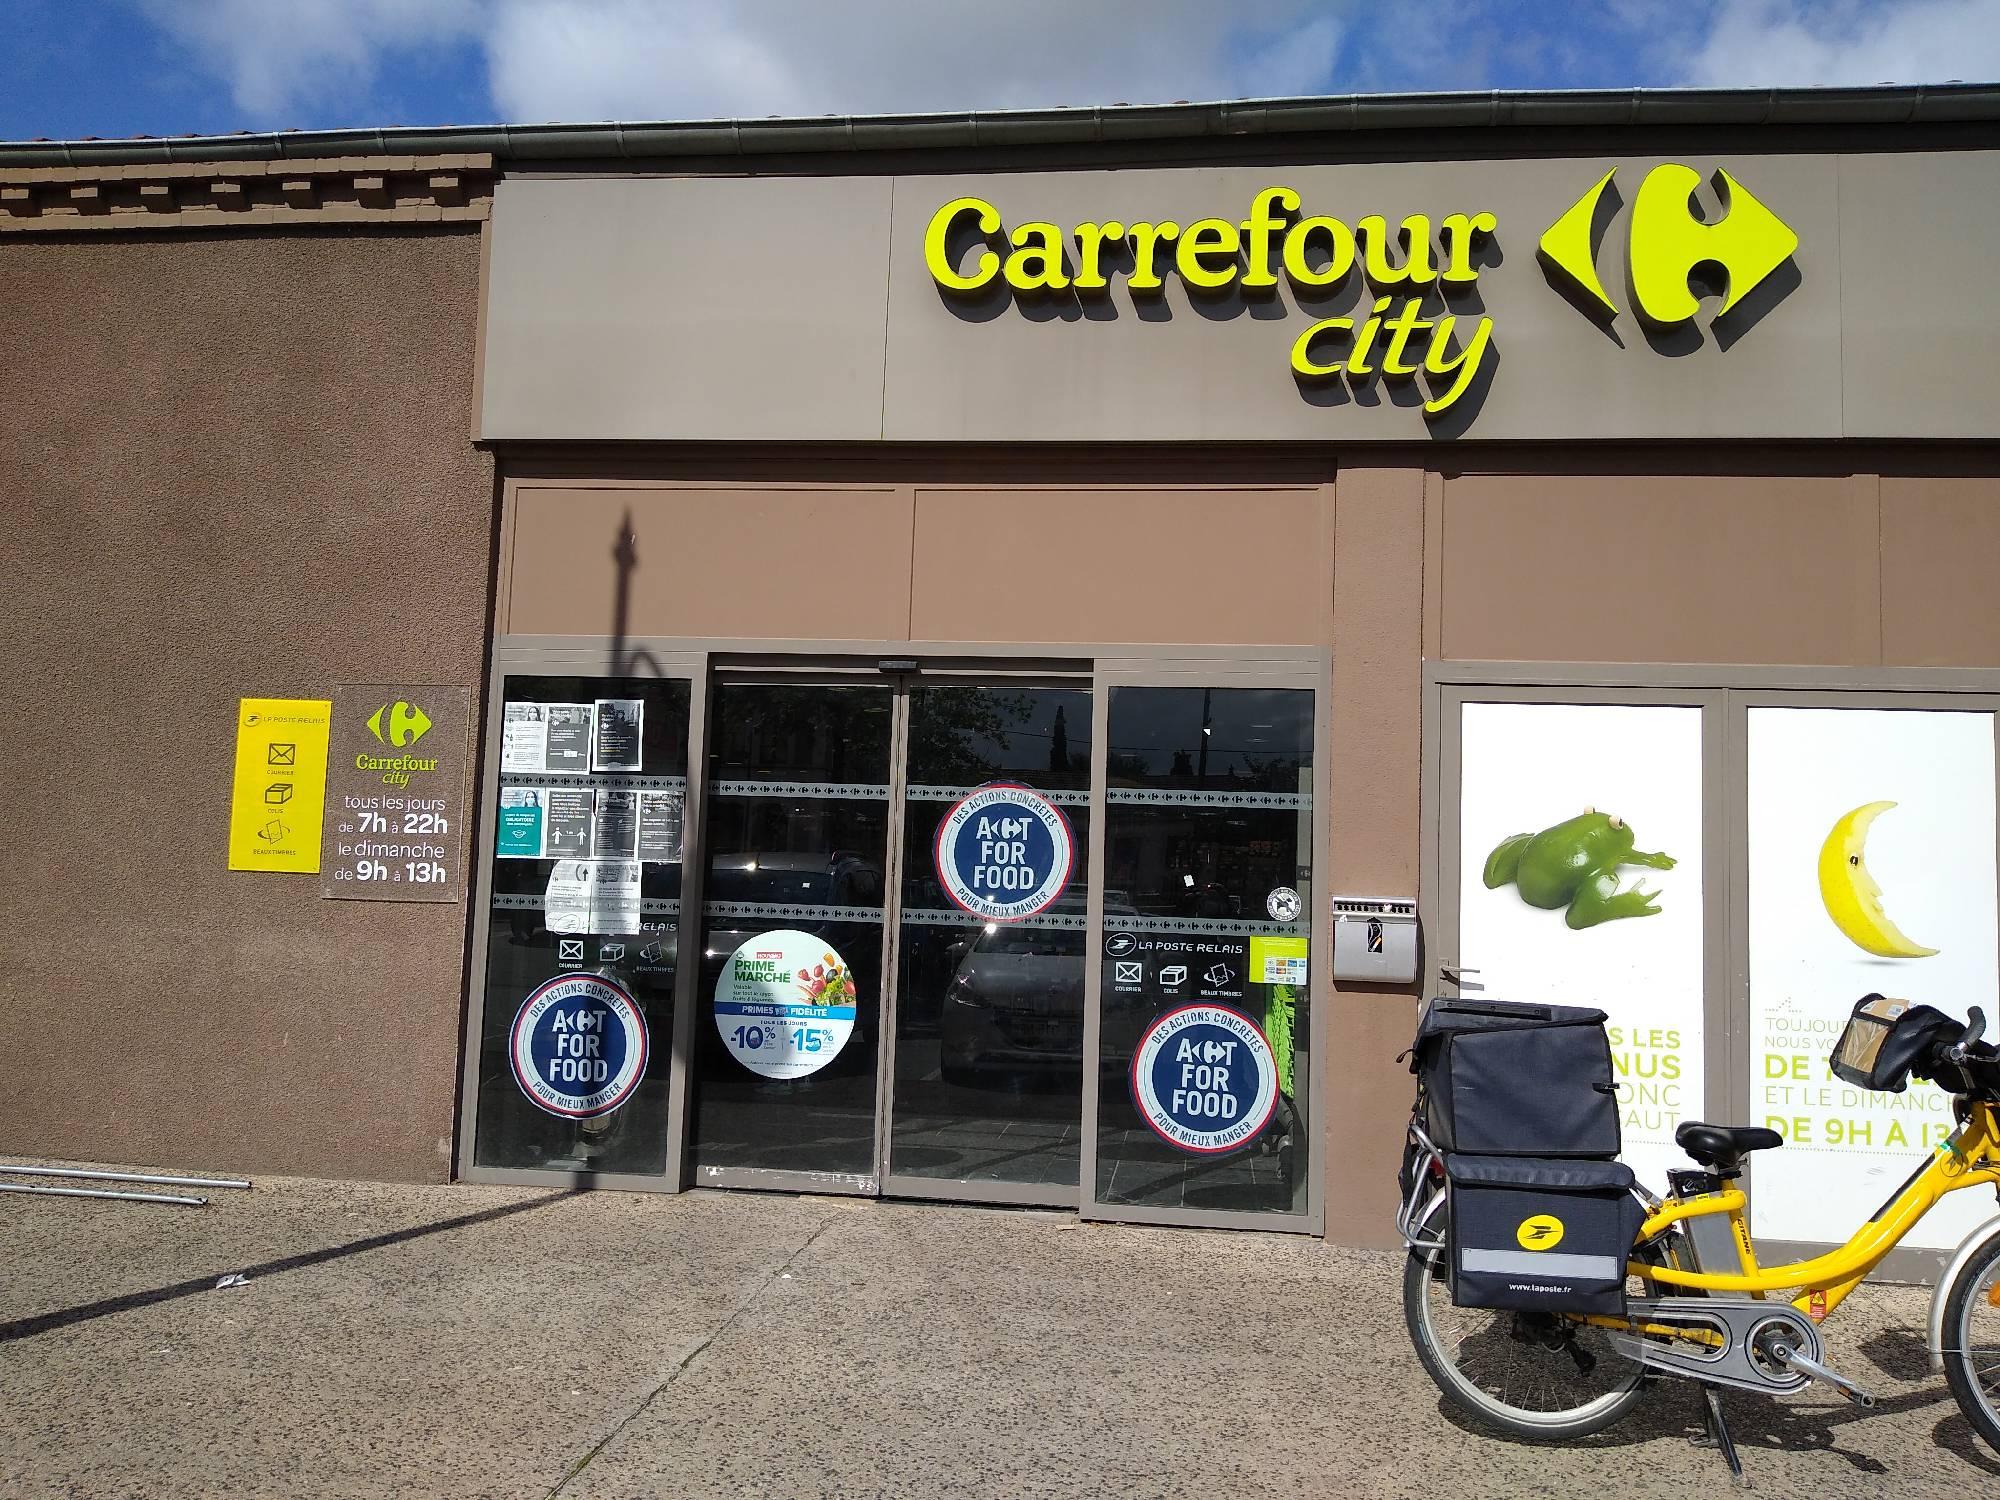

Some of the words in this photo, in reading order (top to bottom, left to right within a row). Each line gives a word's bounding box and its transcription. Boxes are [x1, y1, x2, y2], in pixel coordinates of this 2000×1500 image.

[924, 186, 1497, 290] Carrefour
[1291, 295, 1494, 414] city
[356, 753, 438, 771] Carrefour
[382, 771, 411, 789] city
[345, 795, 379, 809] tous
[382, 794, 404, 810] les
[405, 795, 446, 813] jours
[952, 807, 970, 825] DES
[969, 791, 1007, 809] ACTIONS
[338, 822, 354, 833] de
[358, 811, 387, 833] 7h
[391, 821, 399, 834] à
[403, 812, 448, 834] 22h
[338, 841, 352, 856] le
[354, 840, 445, 859] dimanche
[980, 841, 1026, 865] FOR
[334, 867, 353, 880] de
[356, 860, 388, 881] 9h
[393, 870, 401, 882] à
[405, 861, 446, 883] 13h
[973, 866, 1035, 890] FOOD
[956, 887, 980, 909] POUR
[980, 903, 1010, 917] MIEUX
[1012, 891, 1050, 916] MANGER
[636, 921, 677, 932] RELAIS
[1138, 941, 1152, 950] LA
[1156, 942, 1193, 952] POSTE
[1196, 943, 1243, 954] RELAIS
[734, 970, 791, 983] MARCHÉ
[735, 960, 775, 972] PRIME
[530, 999, 546, 1018] DES
[546, 983, 583, 1004] ACTIONS
[742, 1005, 774, 1015] PRIMES
[1151, 1025, 1170, 1045] DES
[1169, 1011, 1210, 1031] ACTIONS
[1608, 1027, 1624, 1046] S
[1633, 1028, 1681, 1049] LES
[557, 1033, 600, 1057] FOR
[1765, 1036, 1811, 1049] NOUS
[1815, 1038, 1837, 1050] VO
[549, 1058, 608, 1082] FOOD
[1181, 1063, 1230, 1092] FOR
[1611, 1052, 1681, 1080] NUS
[1765, 1054, 1810, 1080] DE
[532, 1080, 556, 1103] POUR
[556, 1097, 585, 1110] MIEUX
[587, 1082, 623, 1109] MANGER
[1172, 1089, 1238, 1119] FOOD
[1617, 1082, 1681, 1107] ONC
[1765, 1085, 1795, 1105] ET
[1804, 1087, 1832, 1106] LE
[1153, 1112, 1179, 1137] POUR
[1179, 1130, 1210, 1147] MIEUX
[1213, 1121, 1253, 1146] MANGER
[1624, 1109, 1681, 1131] AUT
[1765, 1115, 1812, 1142] DE
[1825, 1118, 1872, 1146] 9H
[1884, 1118, 1908, 1148] À
[1922, 1122, 1951, 1148] 13
[1508, 1284, 1572, 1293] www.laposte.fr
